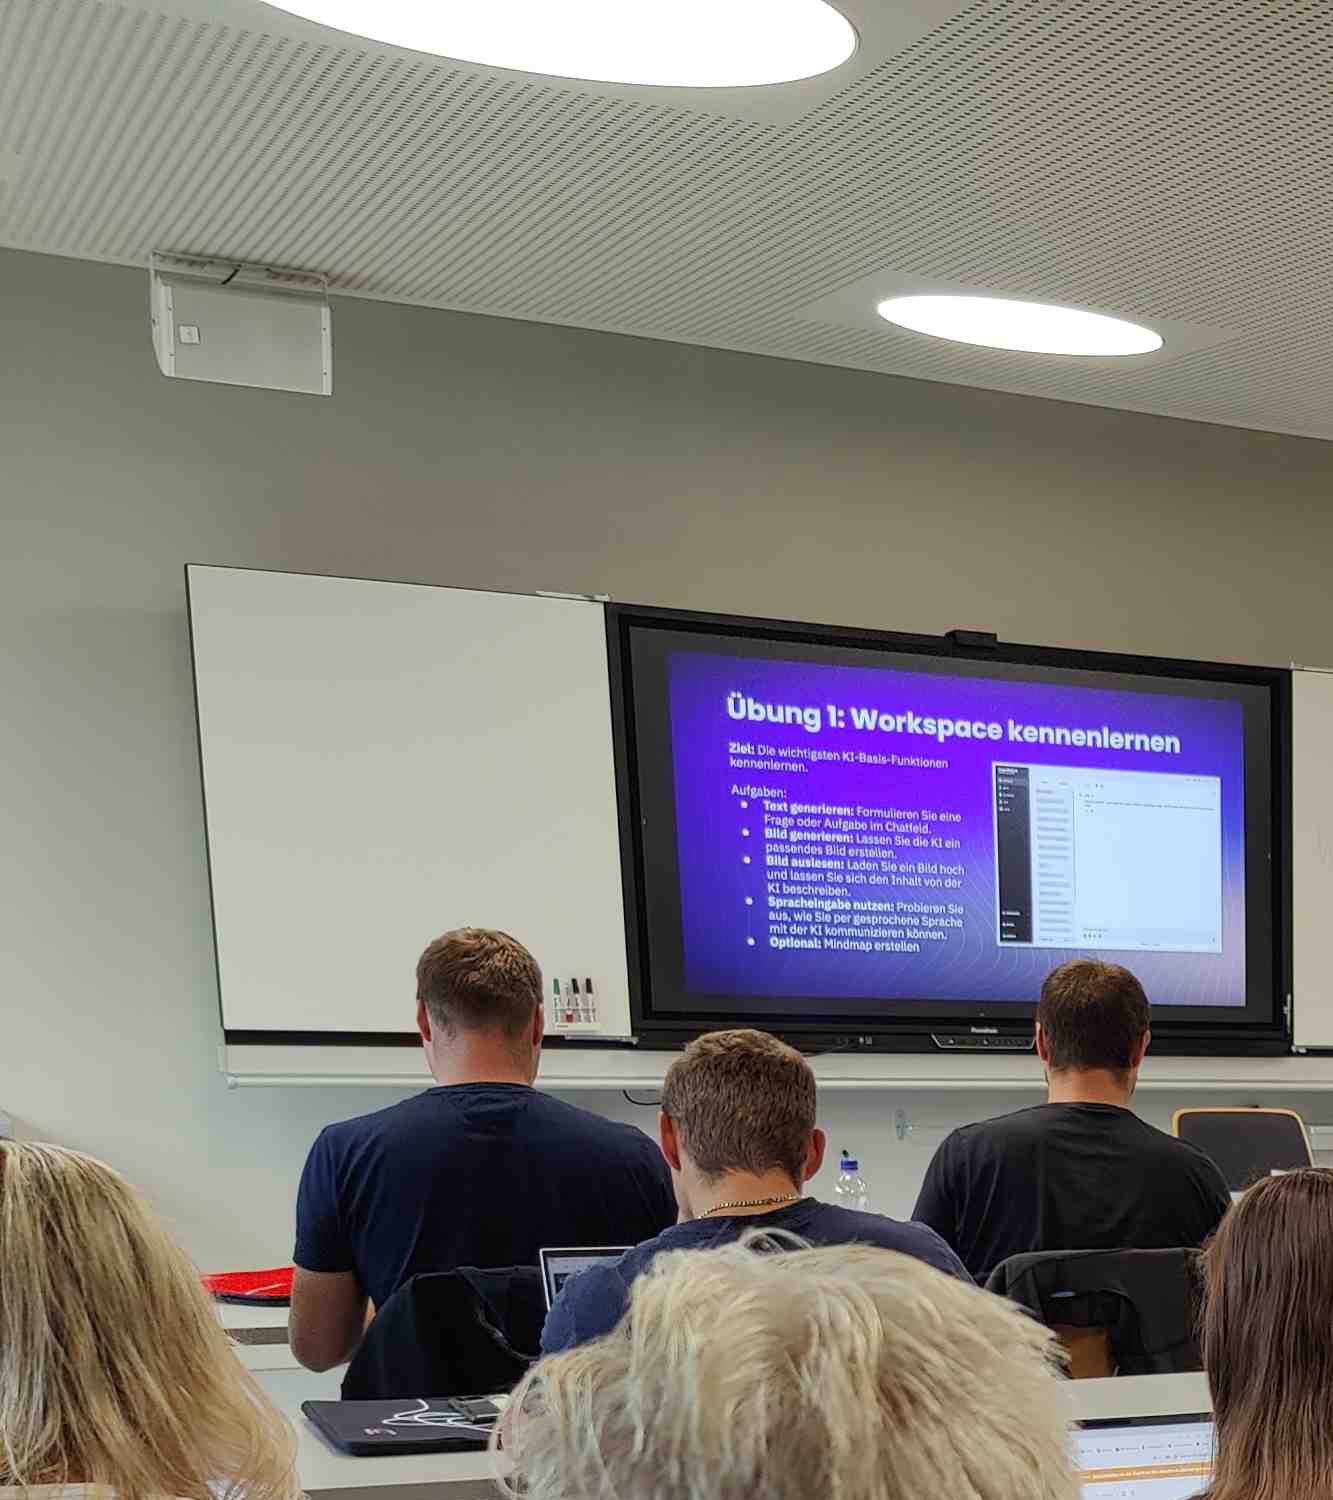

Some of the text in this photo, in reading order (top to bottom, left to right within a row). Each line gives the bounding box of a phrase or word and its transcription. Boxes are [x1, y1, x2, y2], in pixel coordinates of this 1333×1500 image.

[727, 691, 1181, 754] Übung 1: Workspace kennenlernen
[729, 742, 949, 769] Ziel: Die wichtigsten KI-Basis-Funktionen
[729, 756, 808, 773] kennenlernen.
[731, 784, 787, 799] Aufgaben:
[763, 800, 961, 823] Text generieren: Formulieren Sie eine
[764, 814, 932, 835] Frage oder Aufgabe im Chatfeld.
[764, 827, 961, 849] Bild generieren: Lassen Sie die KI ein
[766, 843, 898, 860] passendes Bild erstellen.
[765, 855, 965, 876] Bild auslesen: Laden Sie ein Bild hoch
[767, 869, 962, 889] und lassen Sie sich den Inhalt von der
[767, 882, 851, 897] KI beschreiben.
[768, 896, 964, 915] Spracheingabe nutzen: Probieren Sie
[768, 911, 963, 930] aus, wie Sie per gesprochene Sprache
[769, 924, 948, 941] mit der KI kommunizieren können.
[769, 936, 920, 953] Optional: Mindmap erstellen
